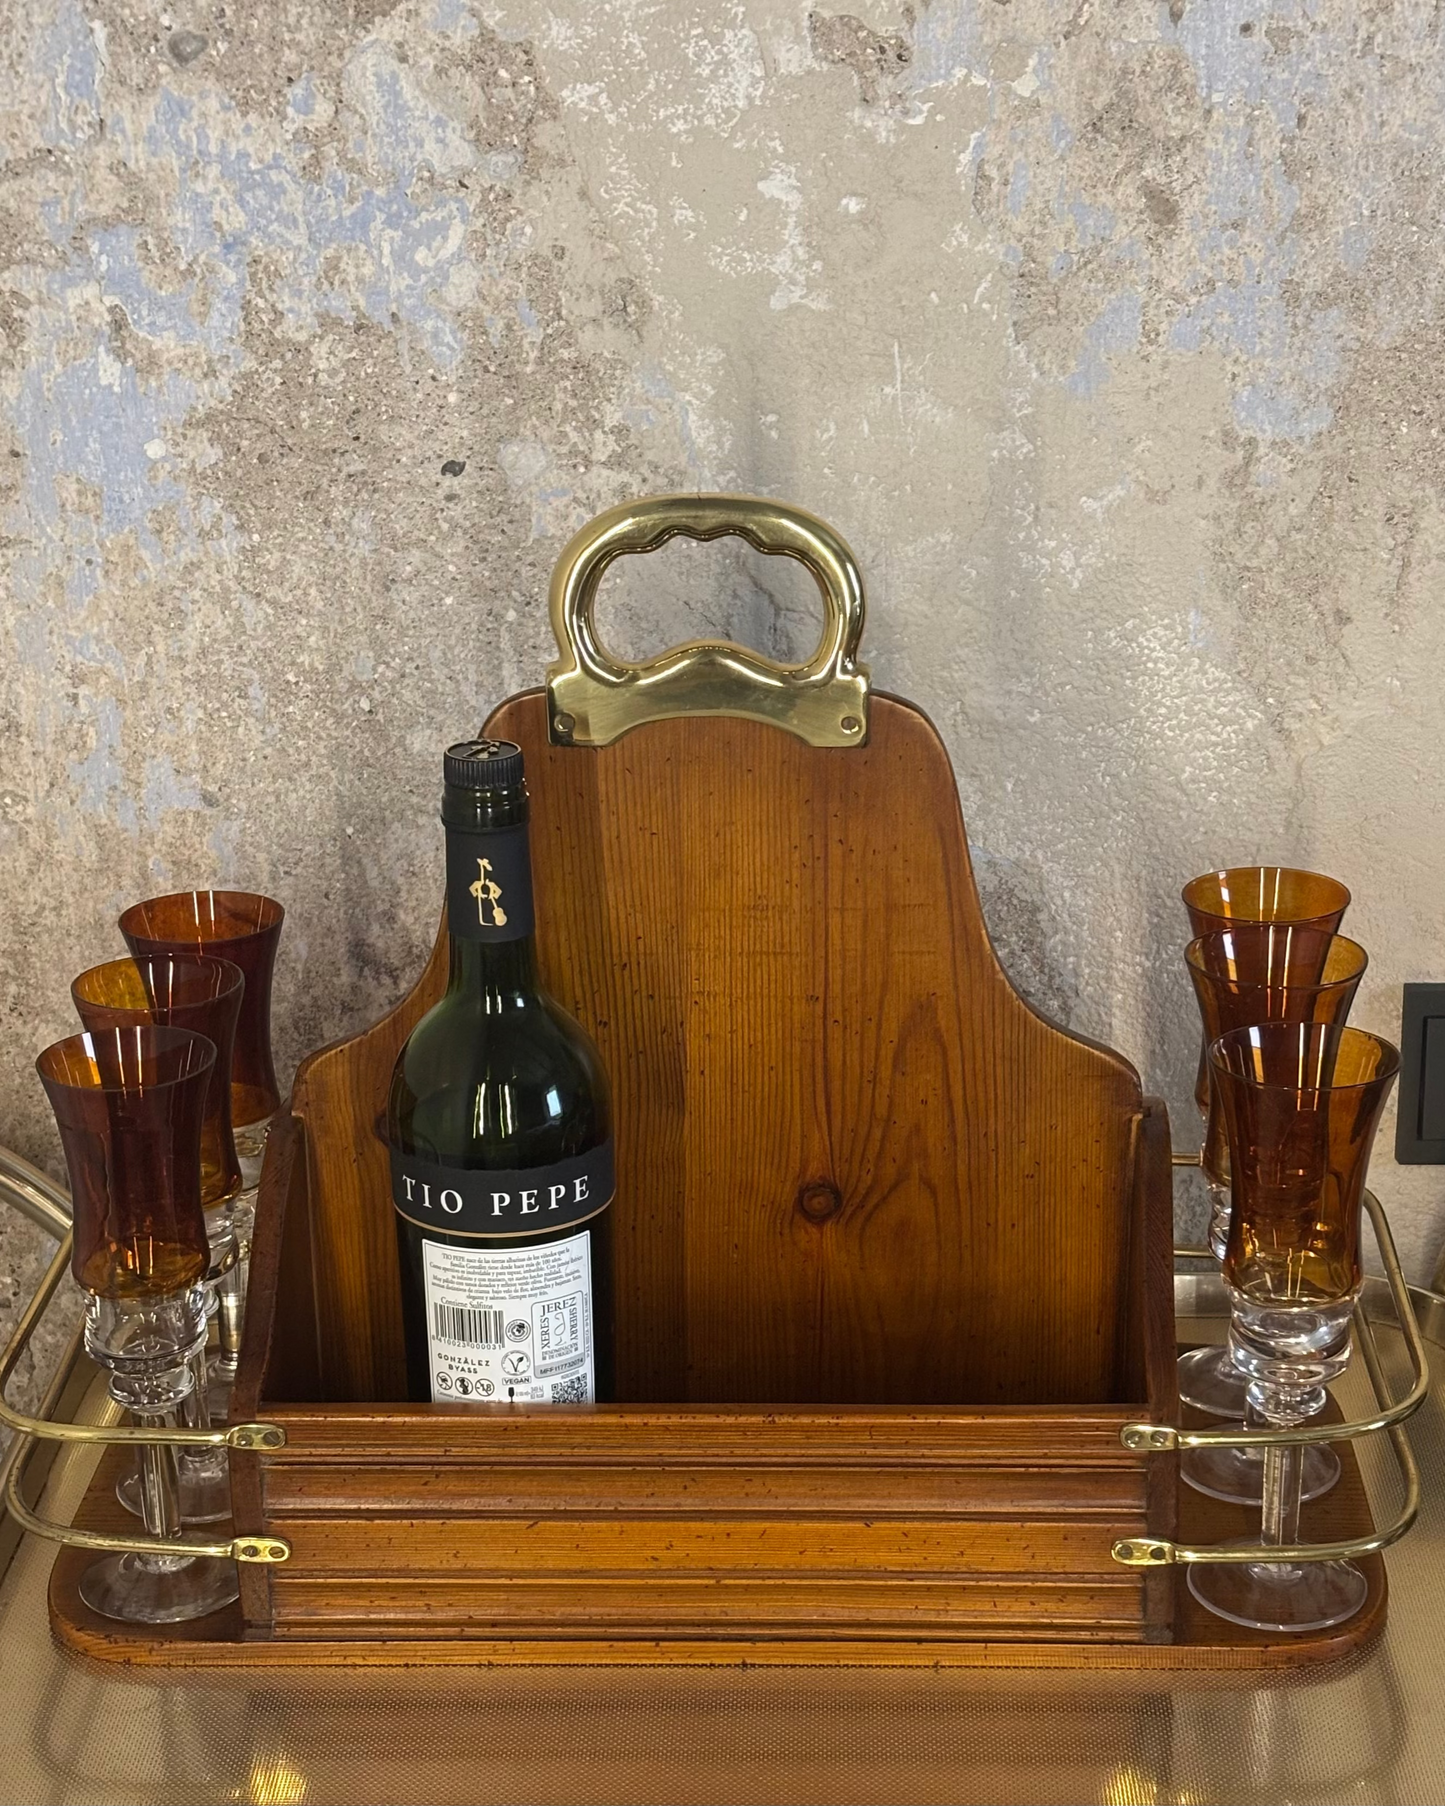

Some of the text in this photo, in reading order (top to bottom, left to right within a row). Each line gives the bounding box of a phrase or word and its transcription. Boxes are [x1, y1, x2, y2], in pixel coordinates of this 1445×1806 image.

[402, 1174, 590, 1216] TIO PEPE
[440, 1296, 493, 1309] Contiene Sulfitos
[540, 1296, 577, 1317] JEREZ
[541, 1317, 550, 1349] XERES
[569, 1307, 578, 1341] SHERRY
[448, 1364, 478, 1374] BYASS
[504, 1377, 530, 1385] VEGAN
